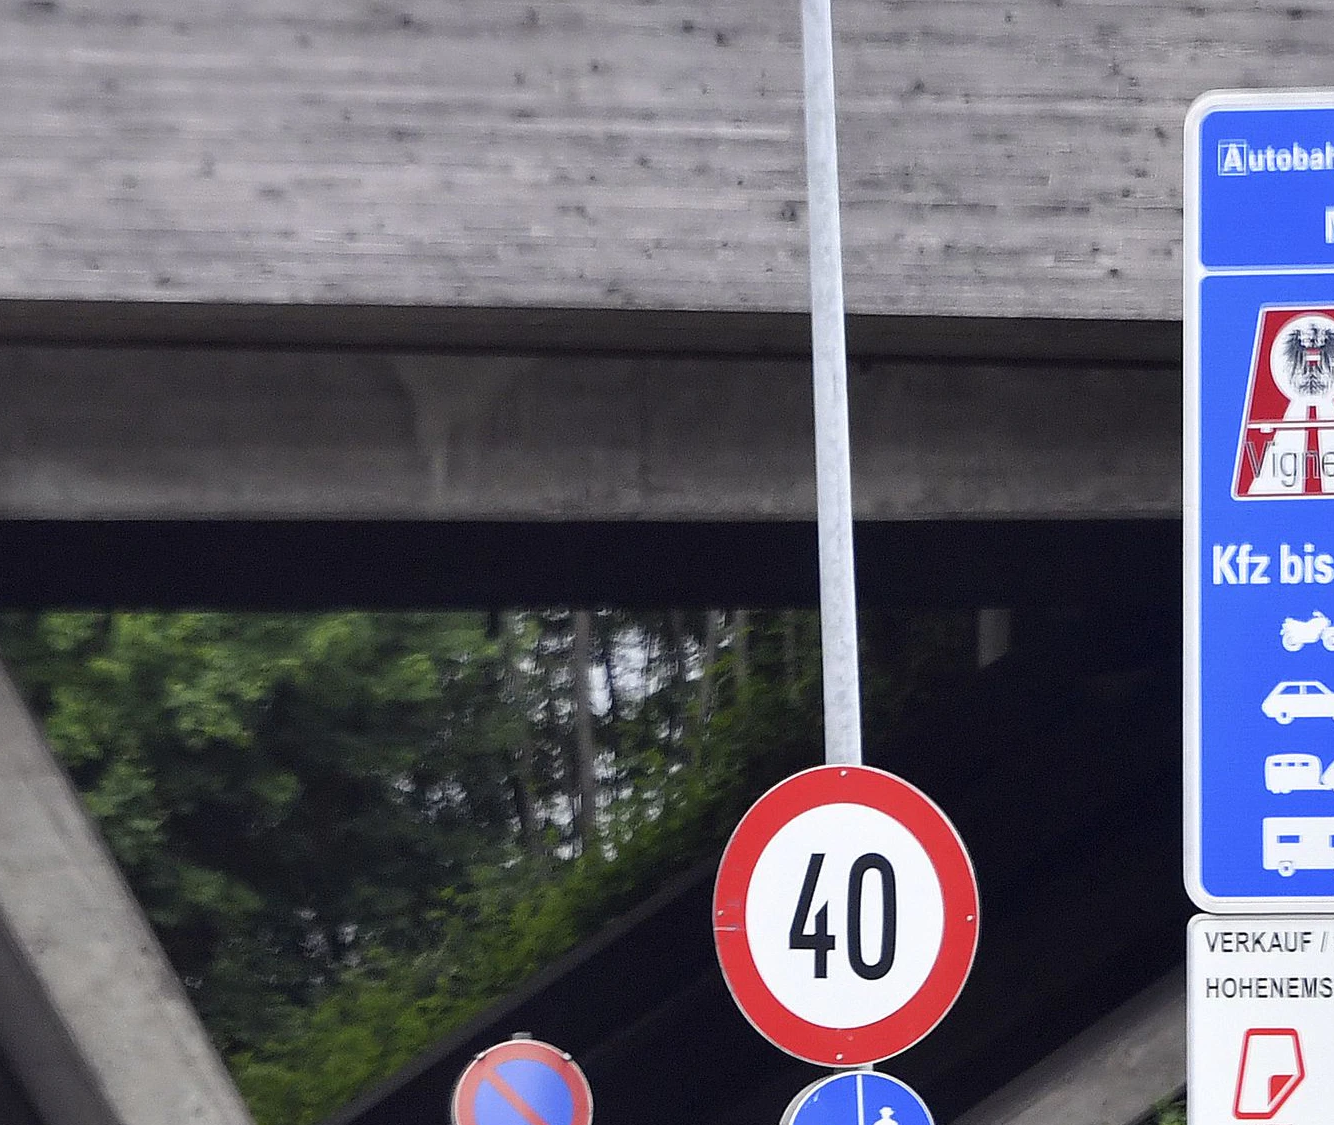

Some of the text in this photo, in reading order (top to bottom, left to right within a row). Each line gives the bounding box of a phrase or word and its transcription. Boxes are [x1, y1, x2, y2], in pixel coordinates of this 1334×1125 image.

[1212, 545, 1271, 586] Kfz
[788, 851, 898, 981] 40
[1204, 930, 1313, 952] VERKAUF
[1205, 977, 1334, 999] HOHENEMS
